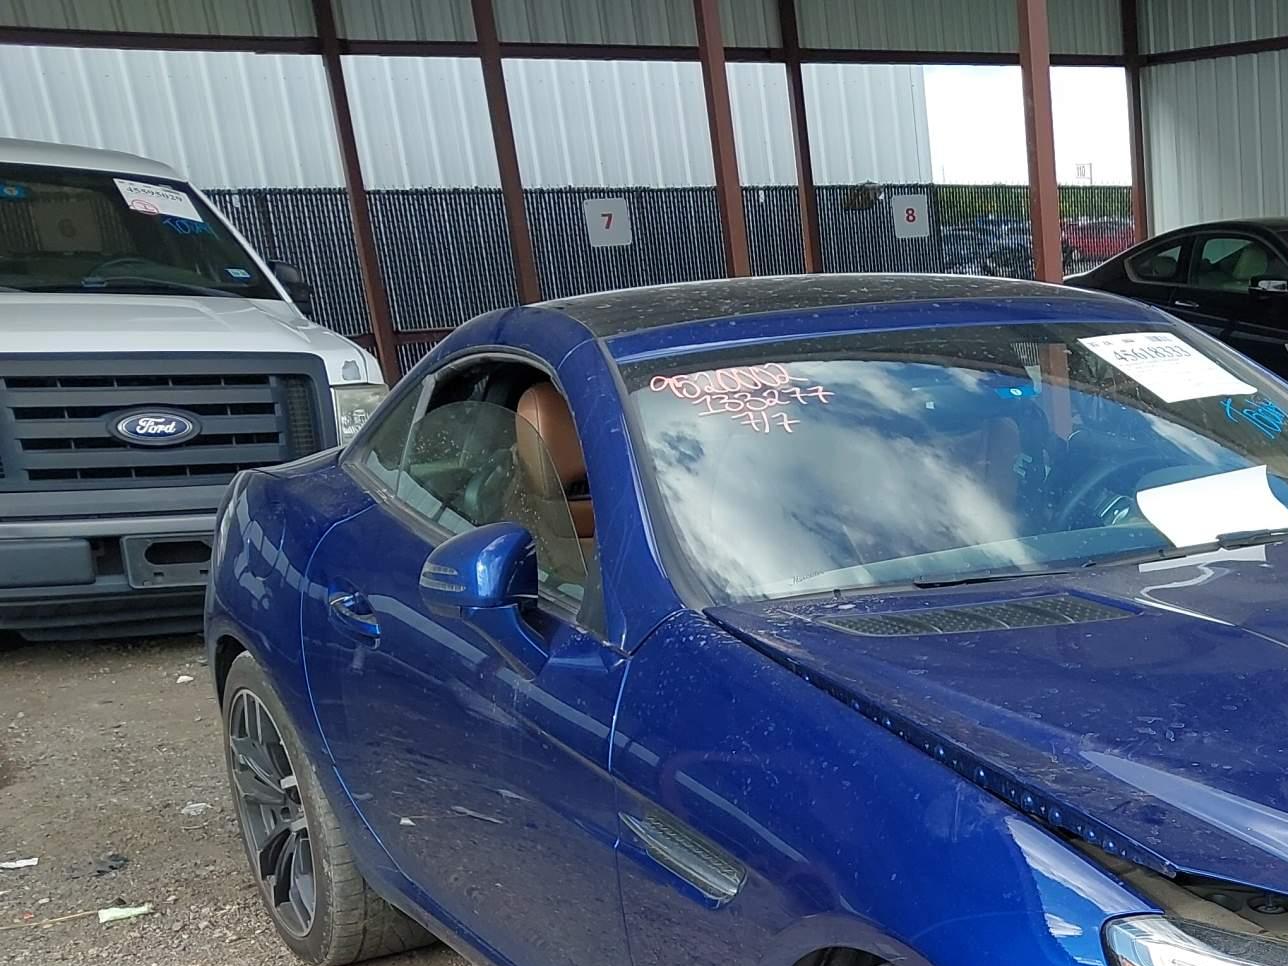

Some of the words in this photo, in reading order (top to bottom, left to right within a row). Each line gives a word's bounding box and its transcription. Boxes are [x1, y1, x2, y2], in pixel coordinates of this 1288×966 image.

[601, 213, 613, 229] 7
[906, 208, 916, 222] 8
[1113, 345, 1192, 362] 45618333
[136, 417, 177, 434] Ford
